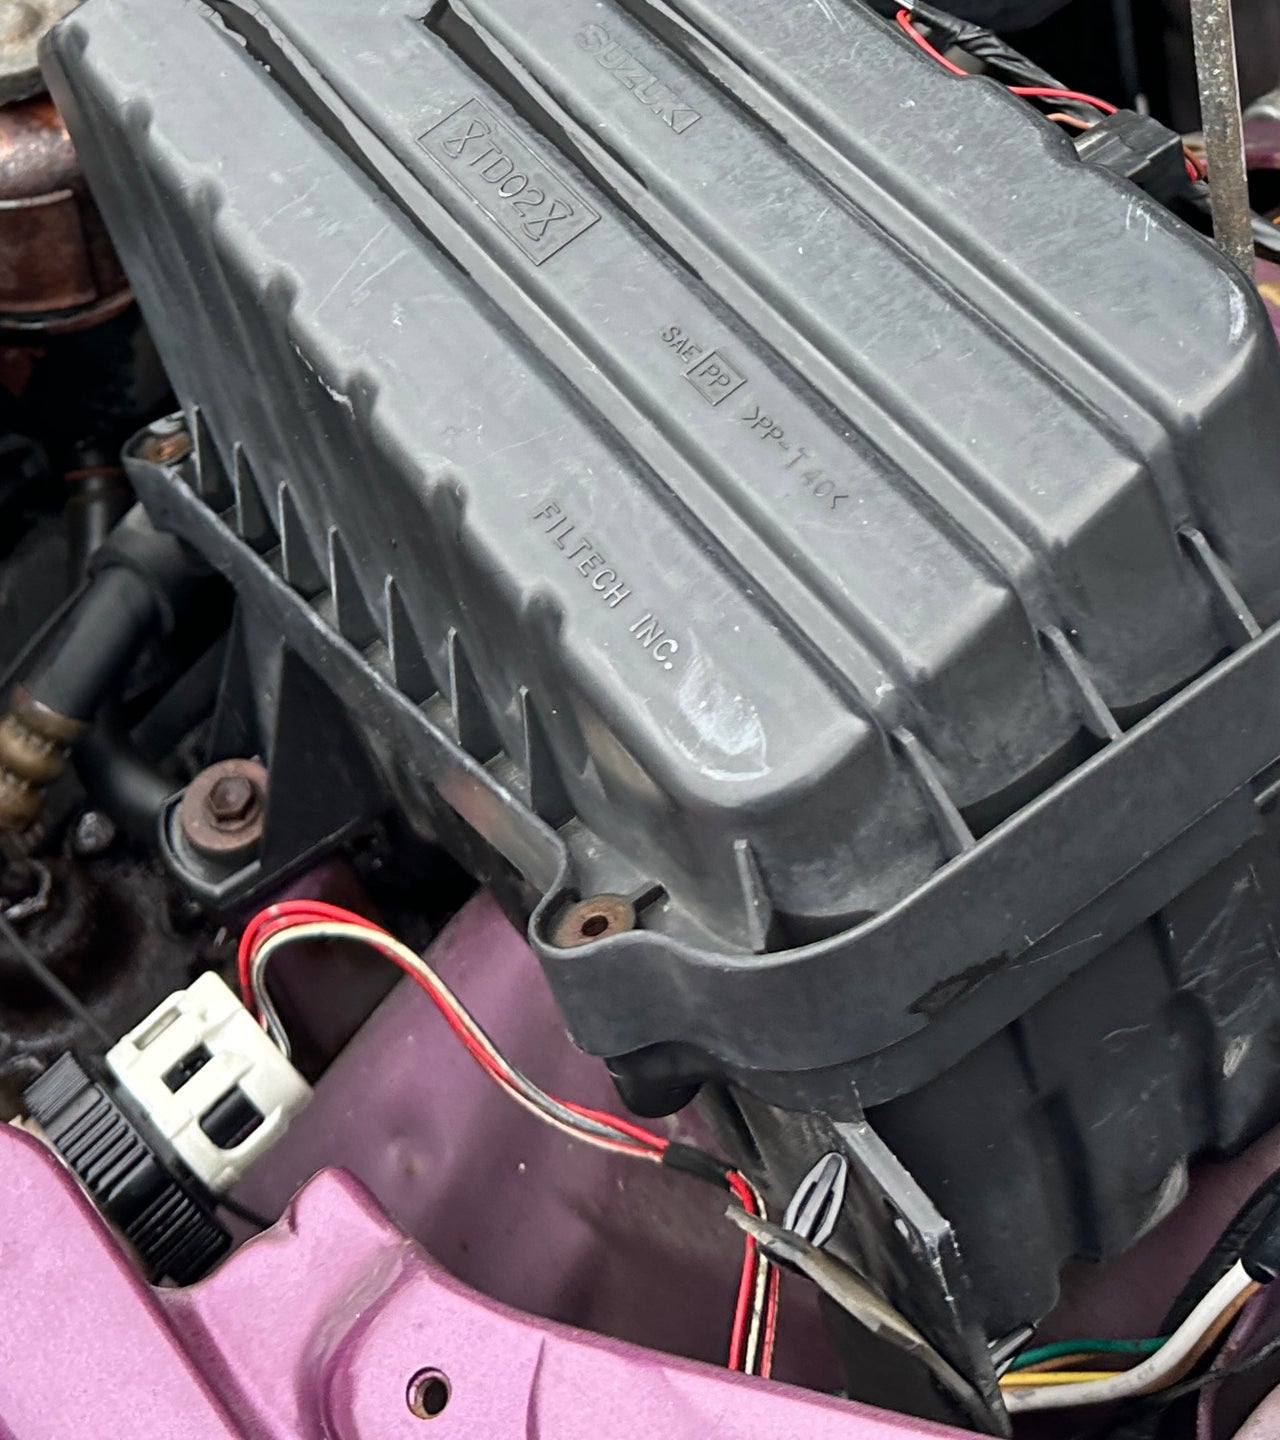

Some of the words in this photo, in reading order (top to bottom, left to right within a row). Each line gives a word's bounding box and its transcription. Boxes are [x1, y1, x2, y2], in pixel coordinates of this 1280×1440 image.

[575, 23, 703, 135] SUZUKI
[661, 326, 703, 364] SAE
[532, 501, 633, 609] FILTECH
[628, 612, 680, 671] INC.
